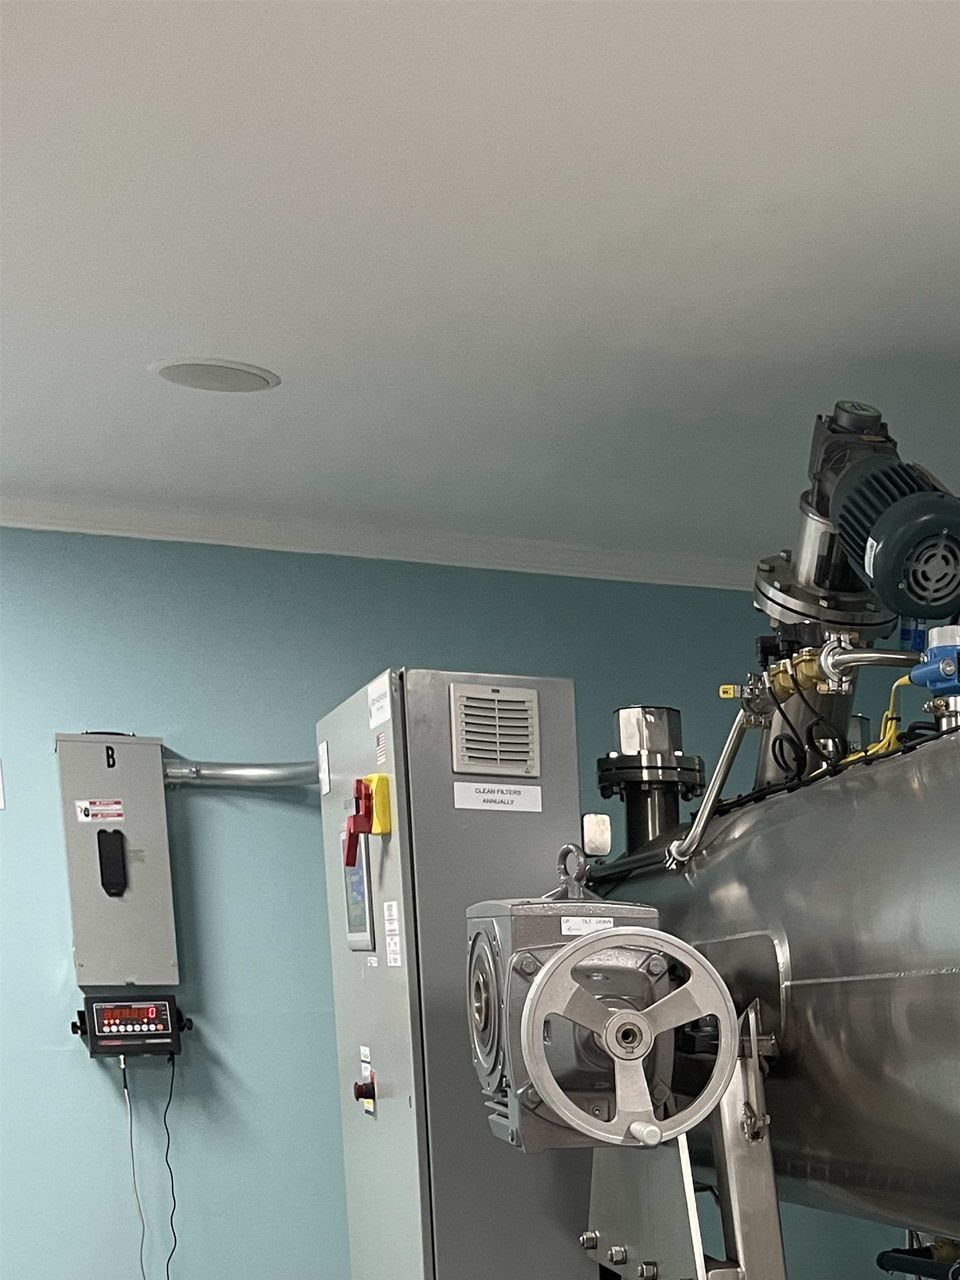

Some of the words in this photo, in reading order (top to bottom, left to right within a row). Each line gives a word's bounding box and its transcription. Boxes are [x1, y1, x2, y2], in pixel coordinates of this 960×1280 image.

[105, 745, 117, 769] B
[474, 787, 496, 795] CLEAN
[496, 788, 522, 796] FILTERS
[482, 798, 516, 806] ANNUALLY
[148, 1007, 157, 1019] 0
